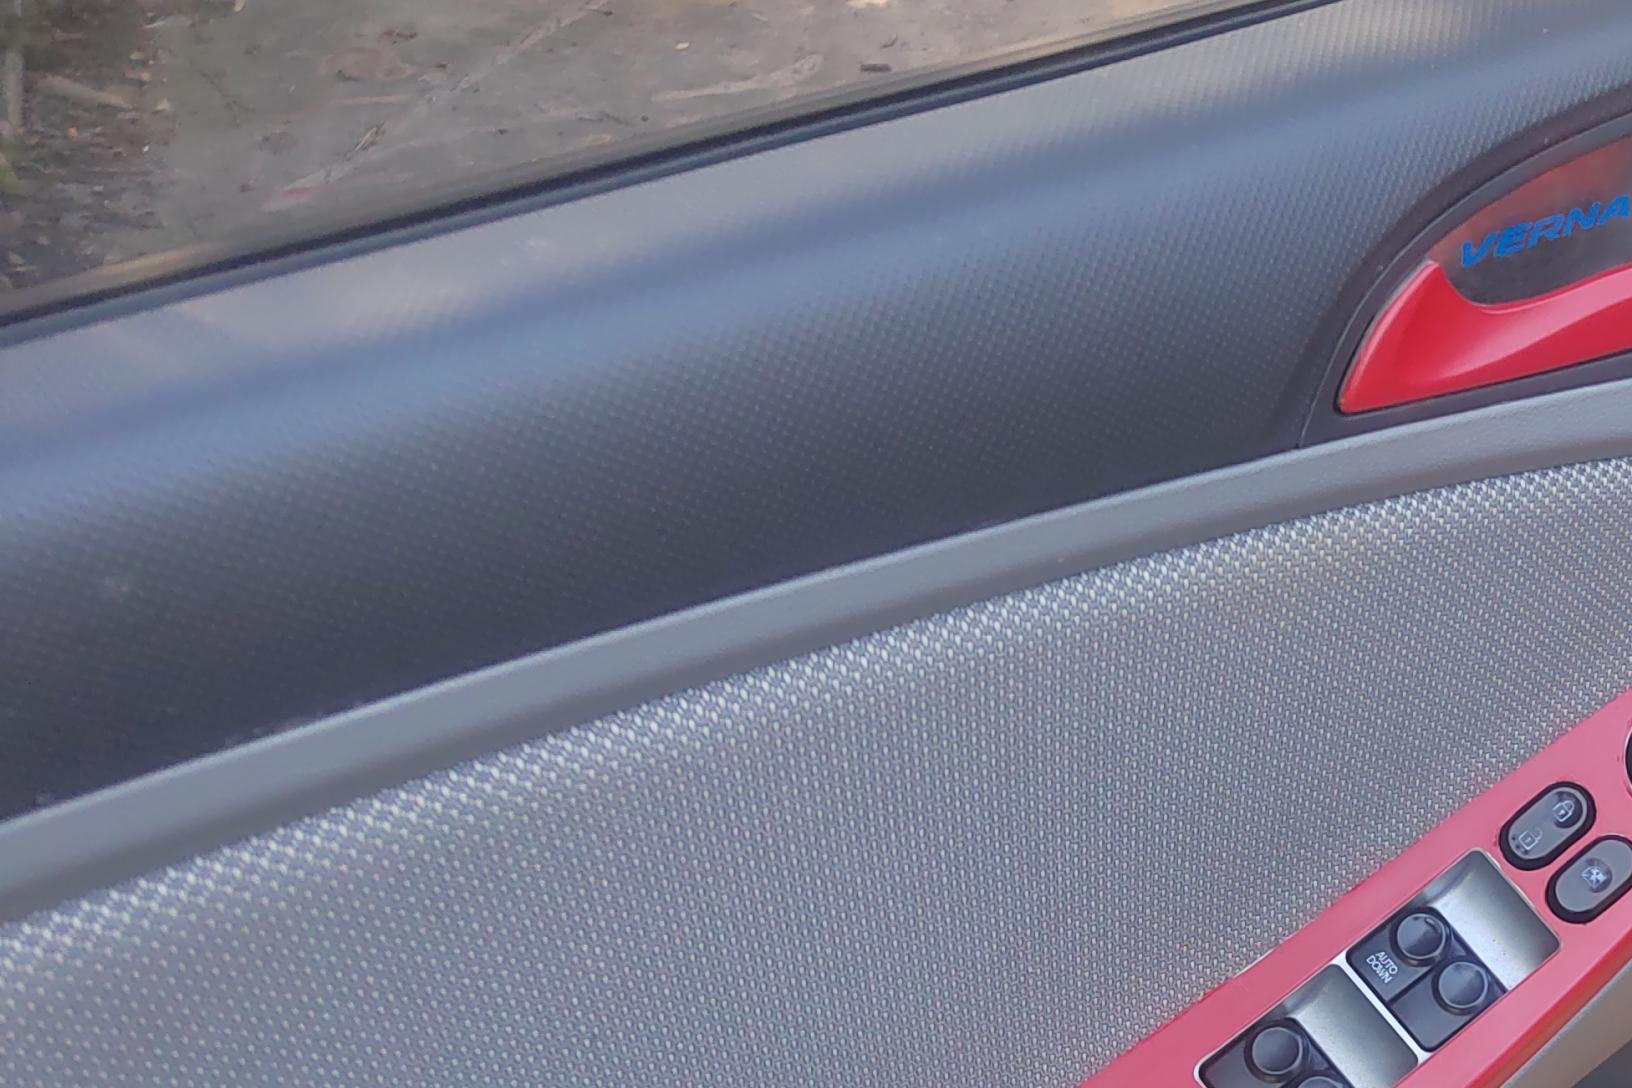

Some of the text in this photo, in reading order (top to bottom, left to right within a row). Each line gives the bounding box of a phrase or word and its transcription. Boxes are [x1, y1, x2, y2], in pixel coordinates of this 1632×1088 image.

[1460, 193, 1632, 268] VERNA
[1366, 955, 1393, 984] DOWN
[1375, 951, 1398, 975] AUTO
